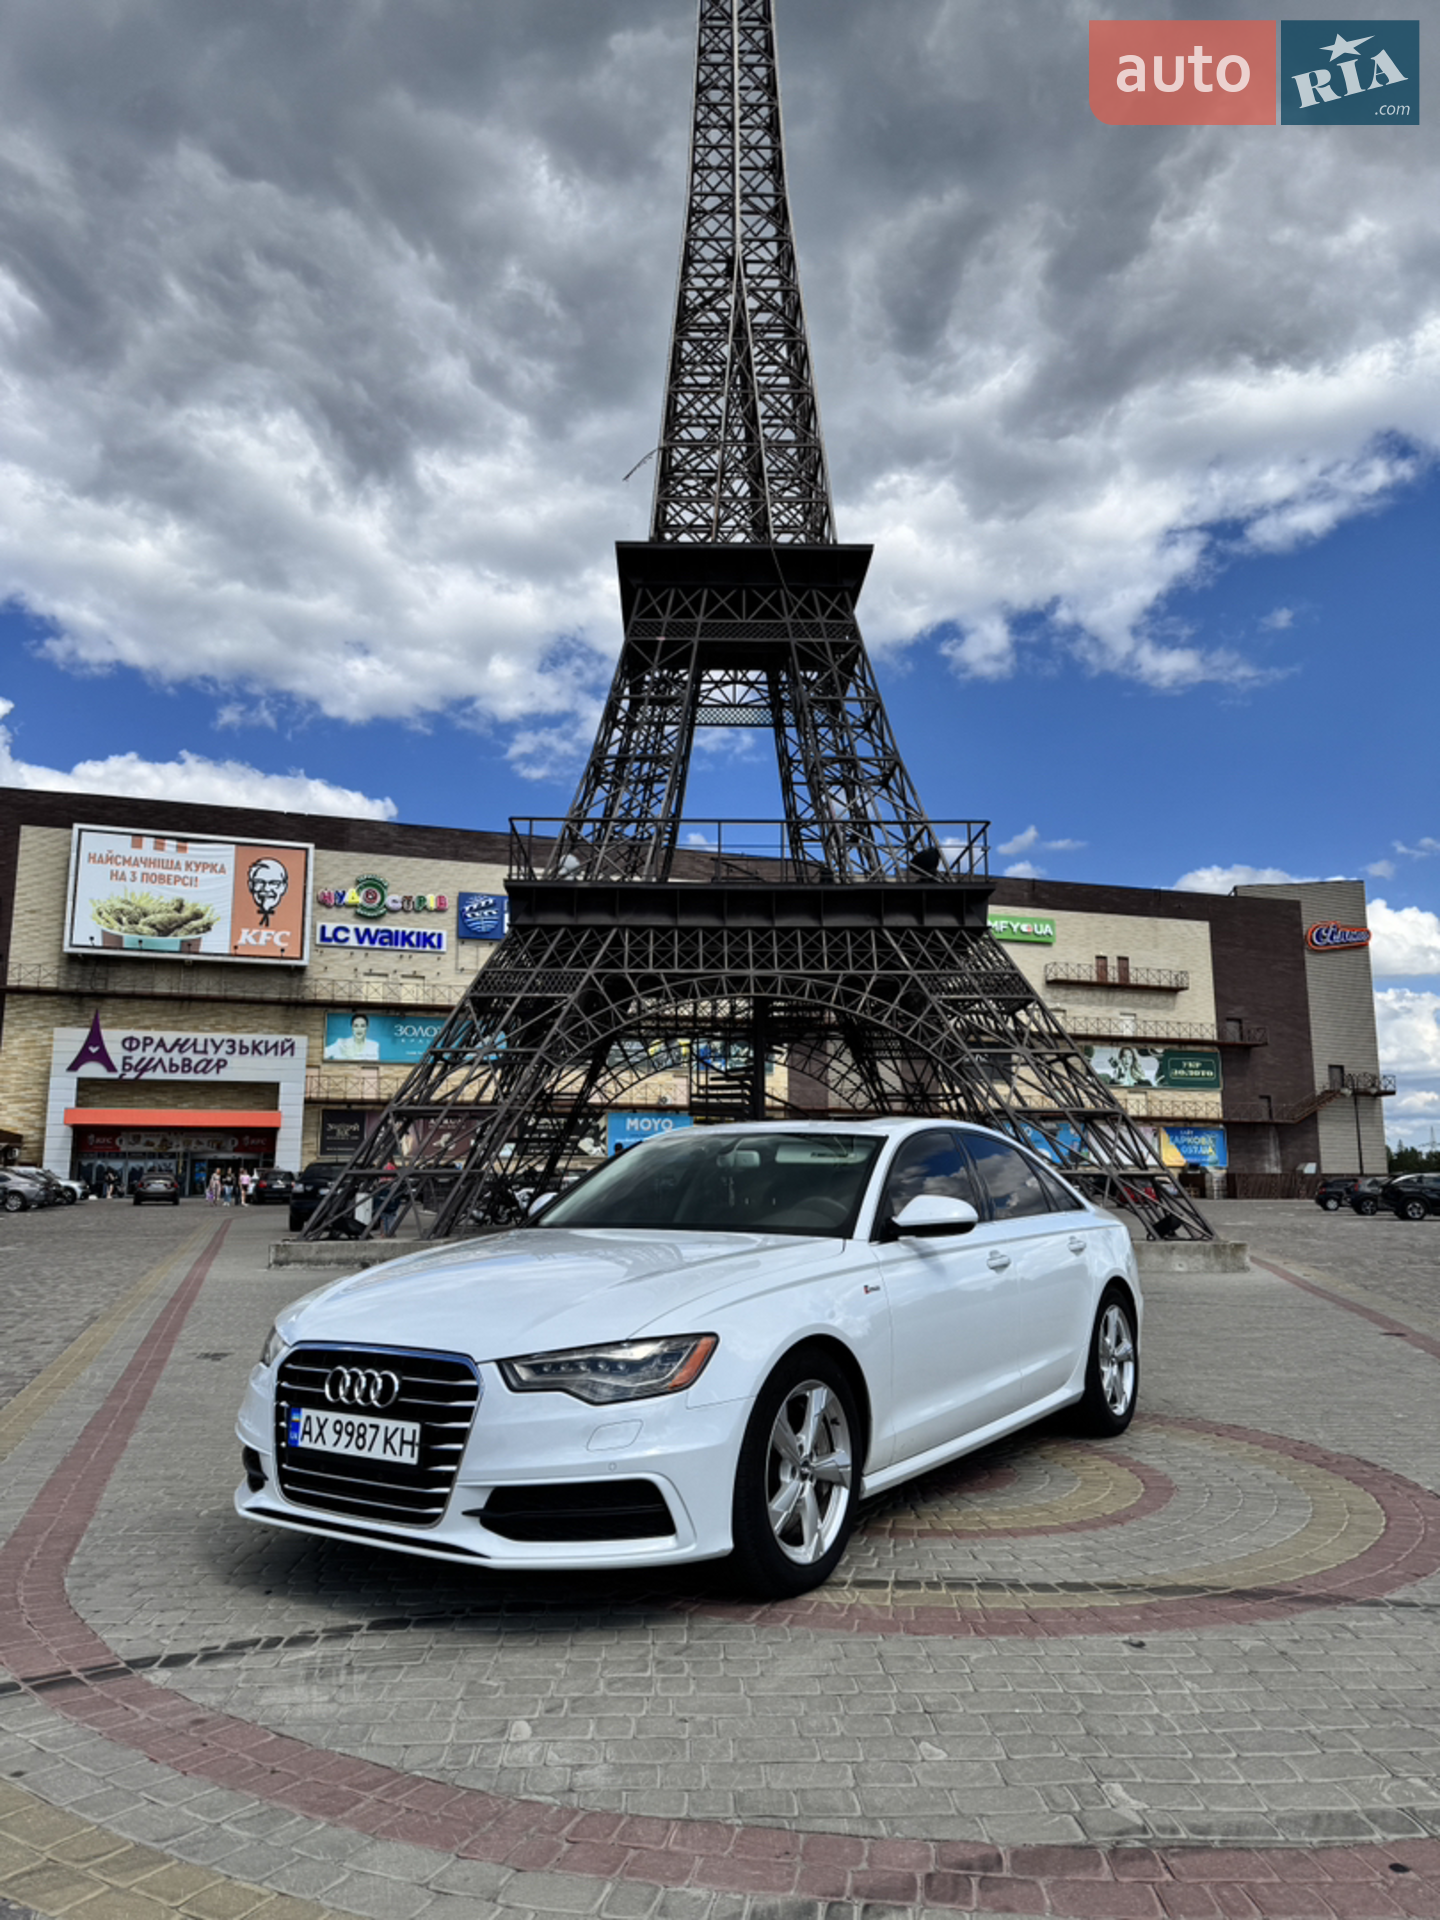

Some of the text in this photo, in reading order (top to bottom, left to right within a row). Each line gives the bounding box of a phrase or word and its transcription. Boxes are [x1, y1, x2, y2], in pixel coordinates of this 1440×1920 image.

[87, 850, 227, 875] НАЙСМАЧНІША КУРКА
[109, 870, 130, 883] НА
[140, 873, 199, 888] ПОВЕРСІ!
[237, 928, 291, 947] KFC
[319, 924, 350, 943] LC
[121, 1035, 296, 1057] ФРАНЦУЗЬКИЙ
[625, 1117, 674, 1132] MOYO
[299, 1414, 417, 1459] AX 9987 KH
